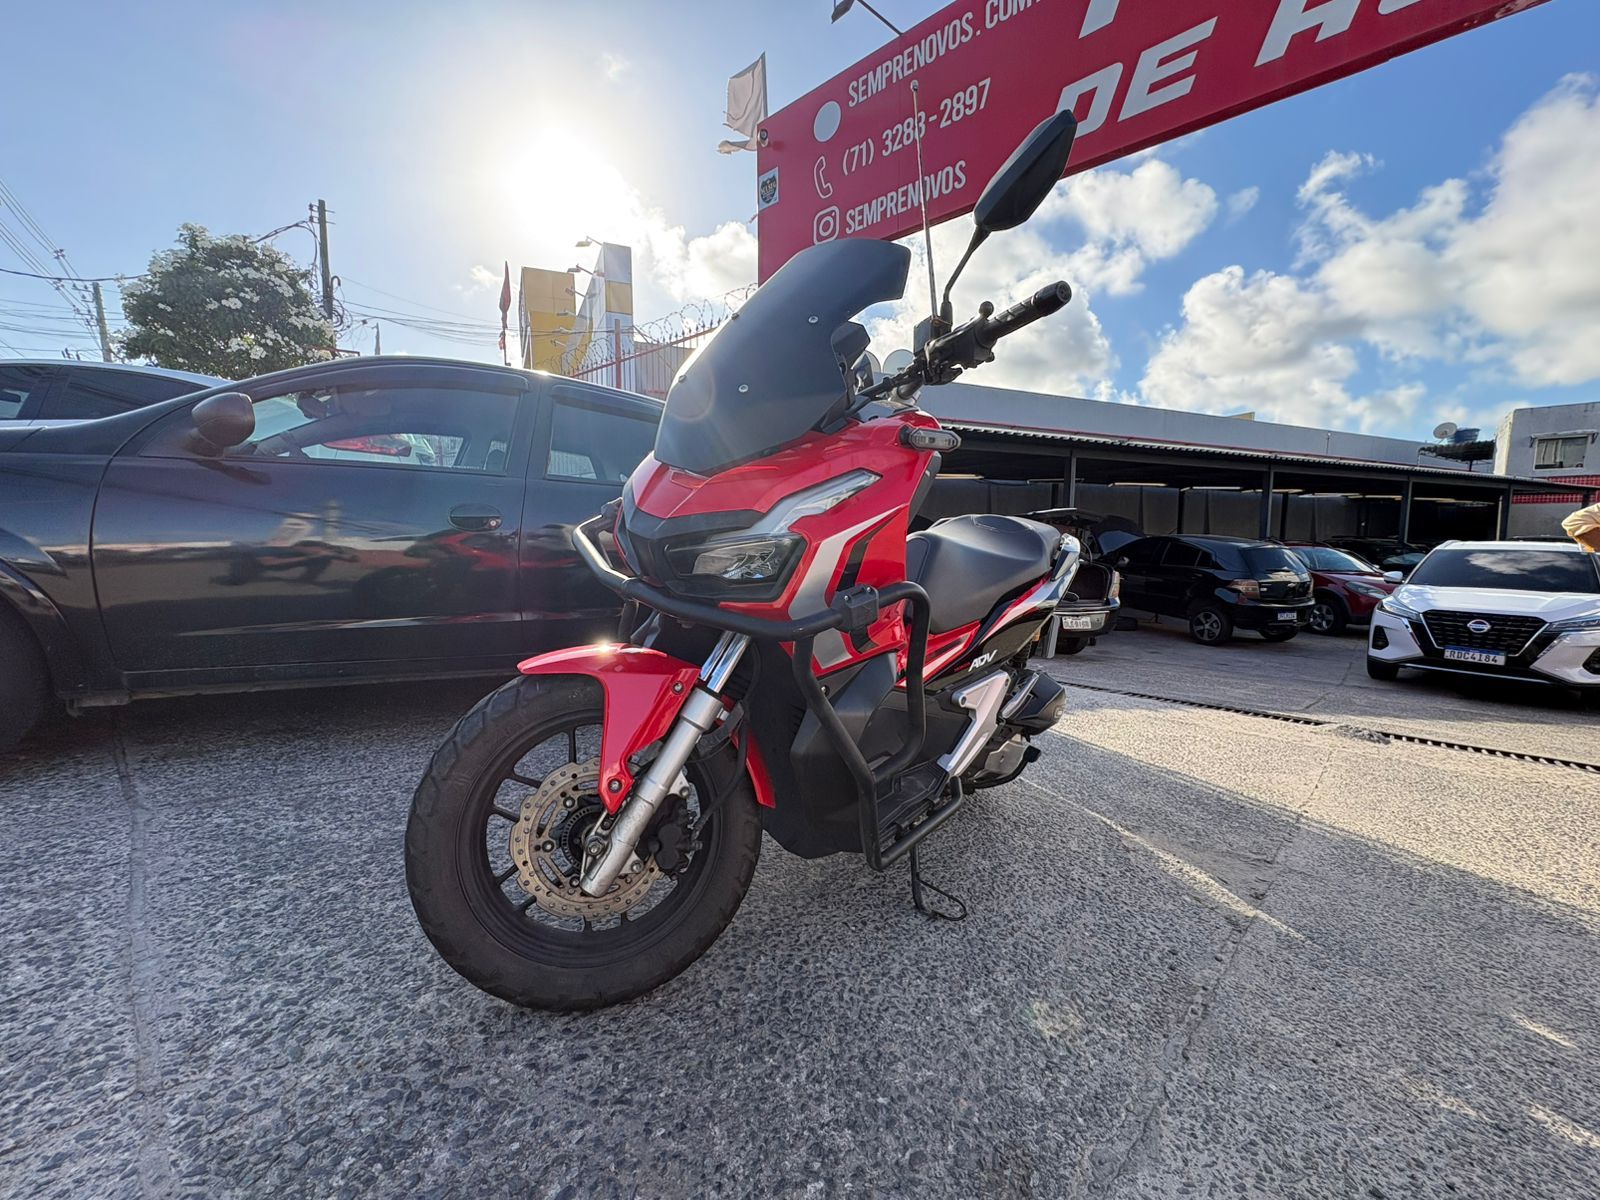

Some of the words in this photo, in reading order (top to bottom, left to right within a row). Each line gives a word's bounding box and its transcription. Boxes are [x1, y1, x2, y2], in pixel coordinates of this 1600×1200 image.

[1053, 15, 1219, 139] DE
[842, 137, 875, 176] (71)
[845, 159, 967, 235] SEMPRENOVOS
[968, 649, 998, 672] ADV
